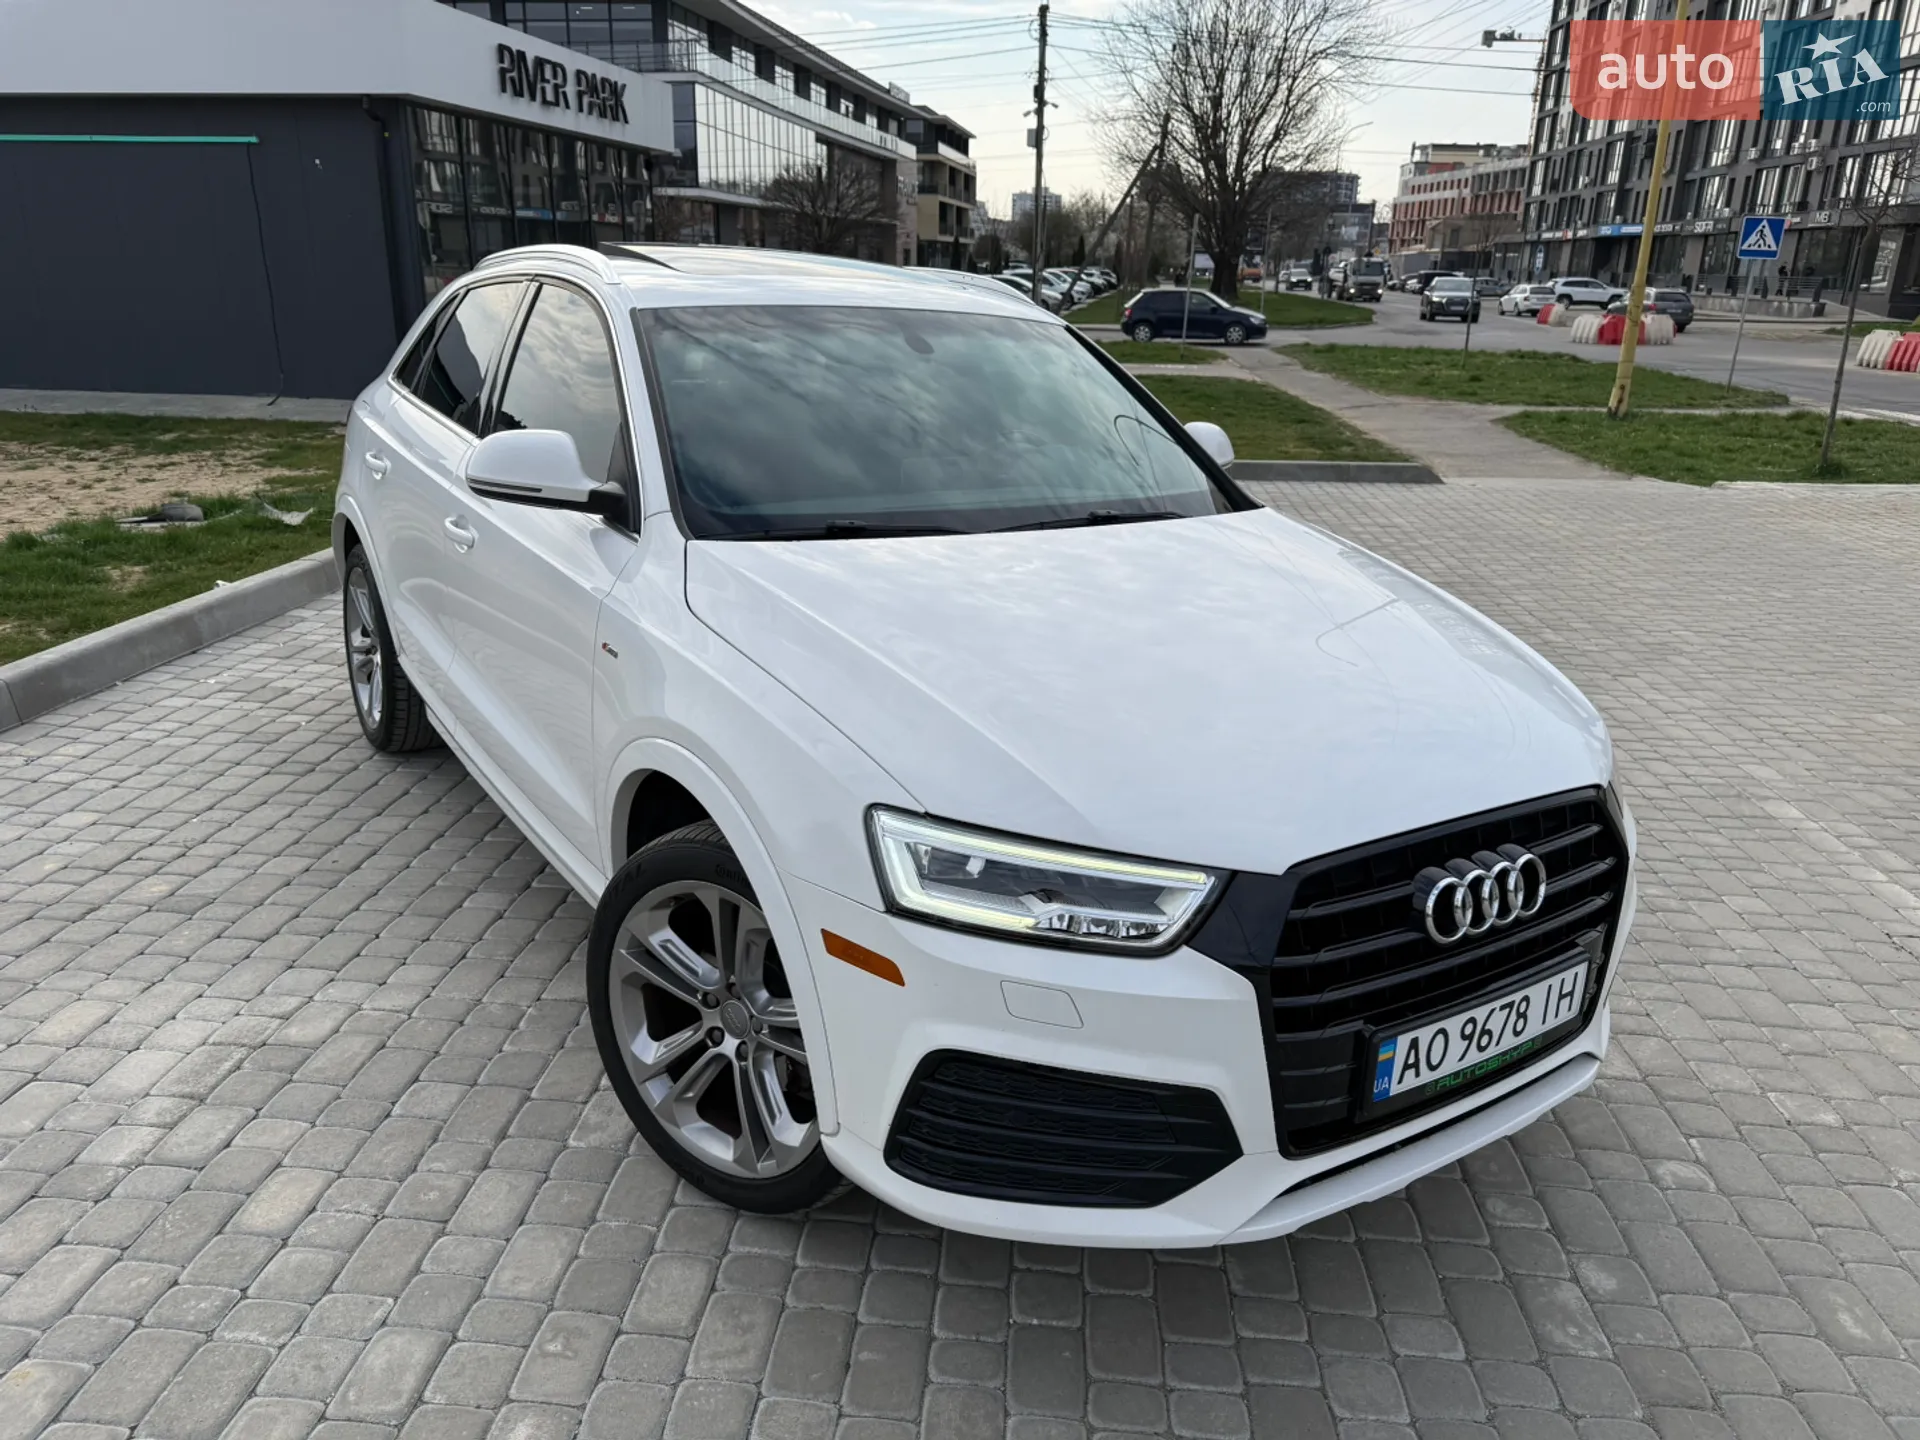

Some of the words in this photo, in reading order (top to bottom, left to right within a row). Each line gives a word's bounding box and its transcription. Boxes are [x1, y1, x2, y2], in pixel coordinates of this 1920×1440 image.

[497, 43, 571, 110] RIVER
[575, 69, 630, 124] PARK
[1397, 1027, 1450, 1085] AO
[1457, 994, 1531, 1062] 9678
[1541, 971, 1579, 1025] IH
[1373, 1076, 1390, 1093] UA
